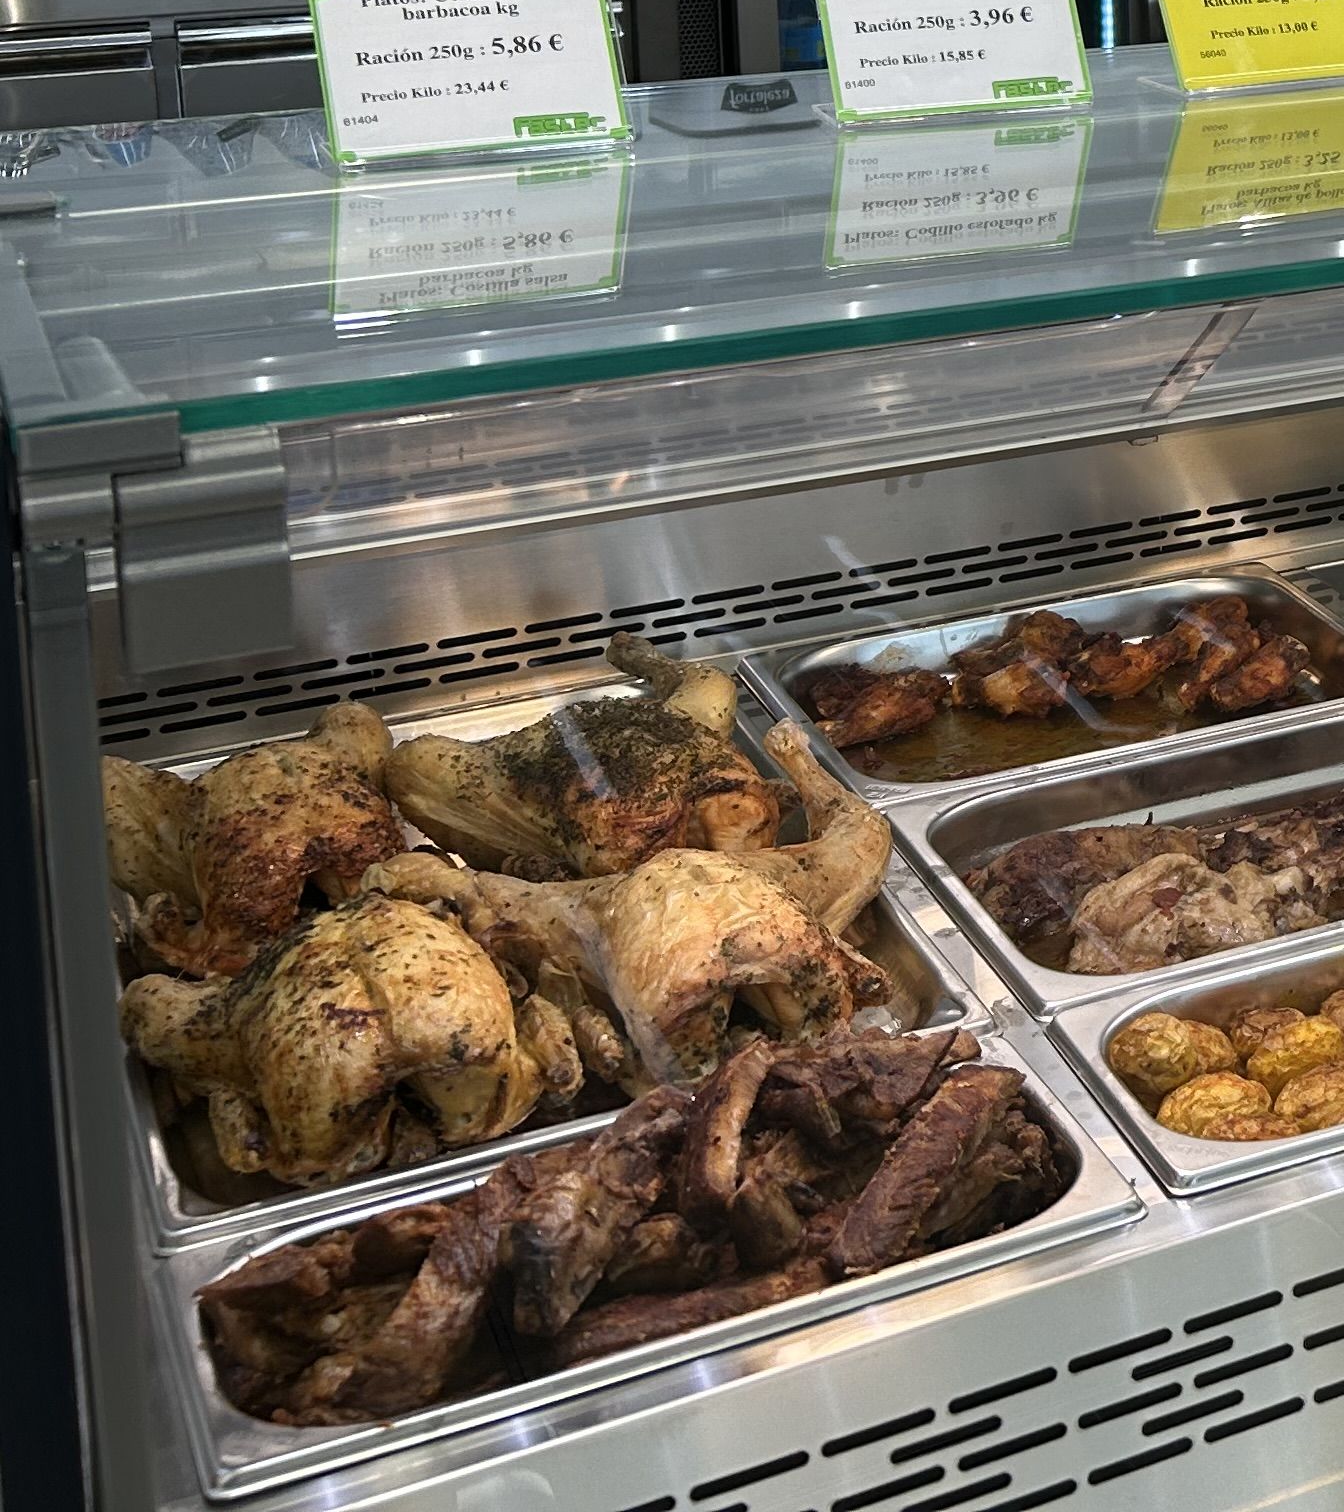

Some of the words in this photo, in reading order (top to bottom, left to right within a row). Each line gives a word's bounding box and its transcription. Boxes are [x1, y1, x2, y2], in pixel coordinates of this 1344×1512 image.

[403, 3, 491, 21] barbacoa
[497, 1, 520, 18] kg
[854, 18, 912, 34] Ración
[918, 15, 956, 30] 250g
[970, 8, 1014, 30] 3,96
[1020, 6, 1034, 23] €
[1210, 28, 1245, 40] Precio
[1247, 26, 1269, 36] Kilo
[1278, 22, 1308, 34] 13,00
[1311, 21, 1319, 31] €
[355, 47, 424, 67] Ración
[430, 44, 475, 61] 250g
[491, 34, 542, 56] 5,86
[548, 33, 565, 53] €
[860, 55, 899, 69] Precio
[903, 54, 928, 66] Kilo
[939, 50, 974, 63] 15,85
[978, 49, 986, 60] €
[361, 88, 408, 104] Precio
[411, 86, 442, 100] Kilo
[455, 80, 496, 96] 23,44
[500, 79, 510, 92] €
